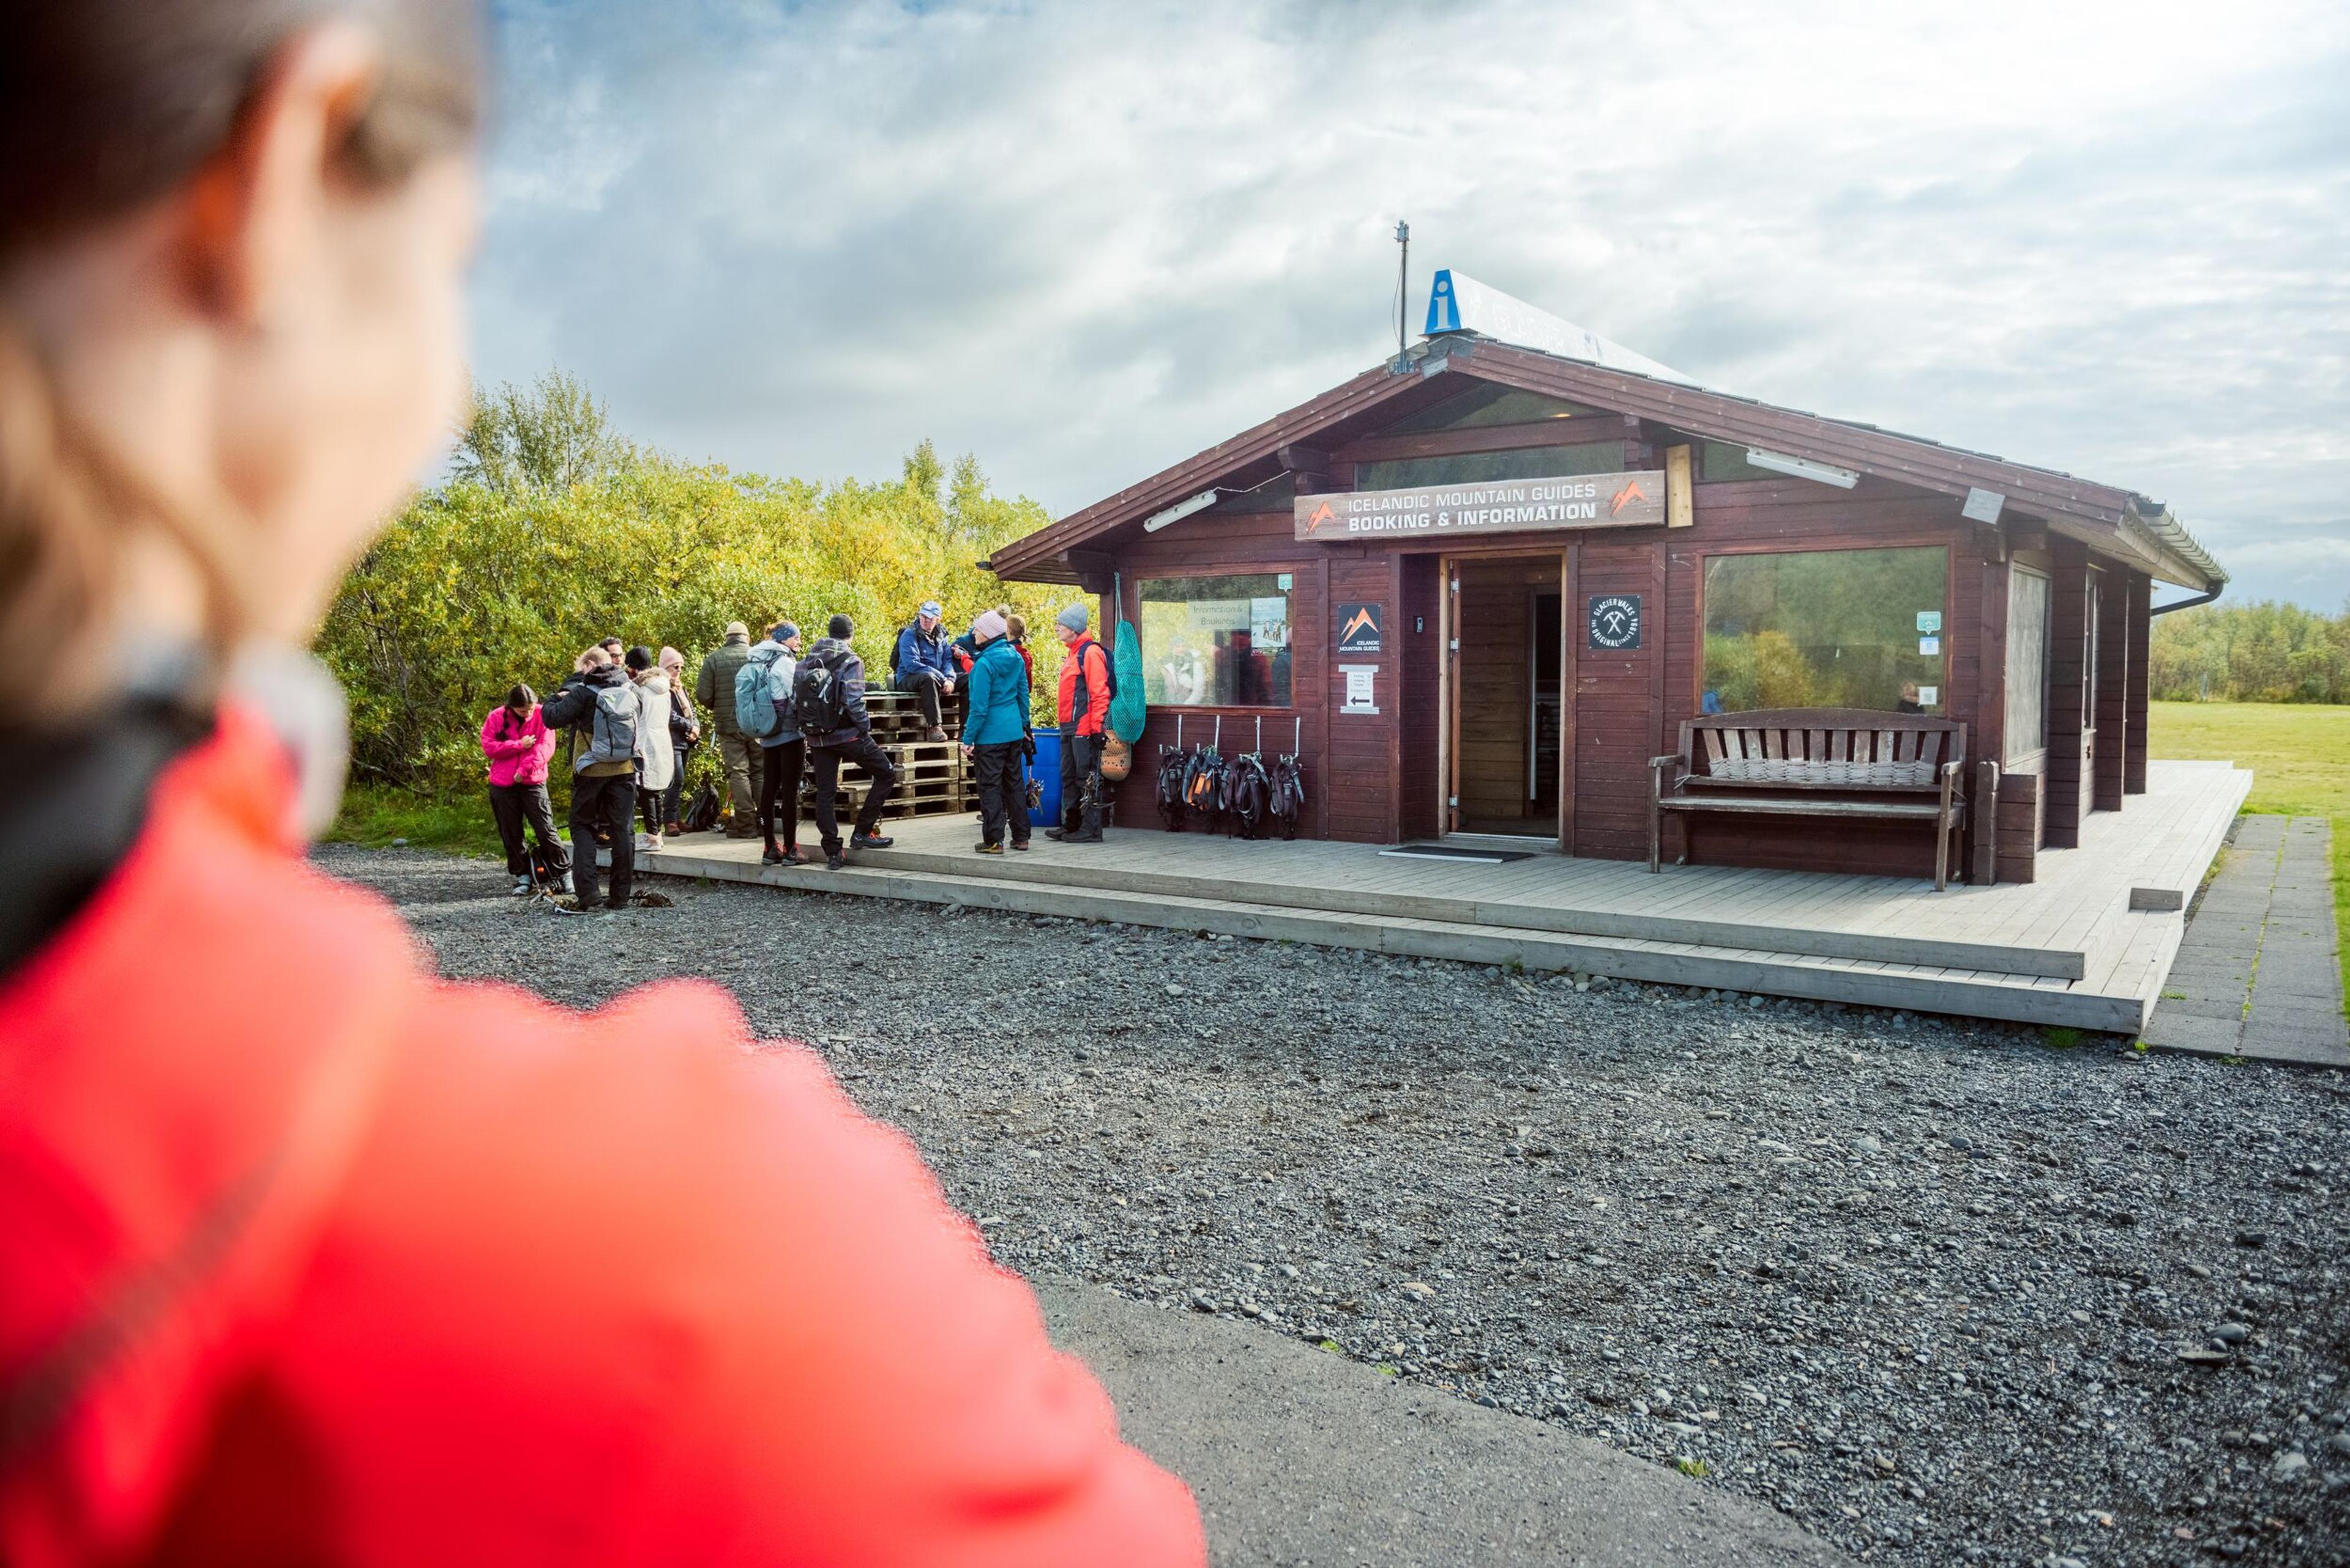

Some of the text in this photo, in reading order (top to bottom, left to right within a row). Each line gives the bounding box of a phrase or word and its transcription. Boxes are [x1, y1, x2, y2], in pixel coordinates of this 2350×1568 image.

[1348, 483, 1595, 513] ICELANDIC MOUNTAIN GUIDES
[1349, 502, 1596, 532] BOOKING & INFORMATION
[1594, 599, 1635, 616] GLACIER WALKS
[1592, 629, 1619, 646] ORIGINAL
[1619, 619, 1638, 644] SINCE 1994
